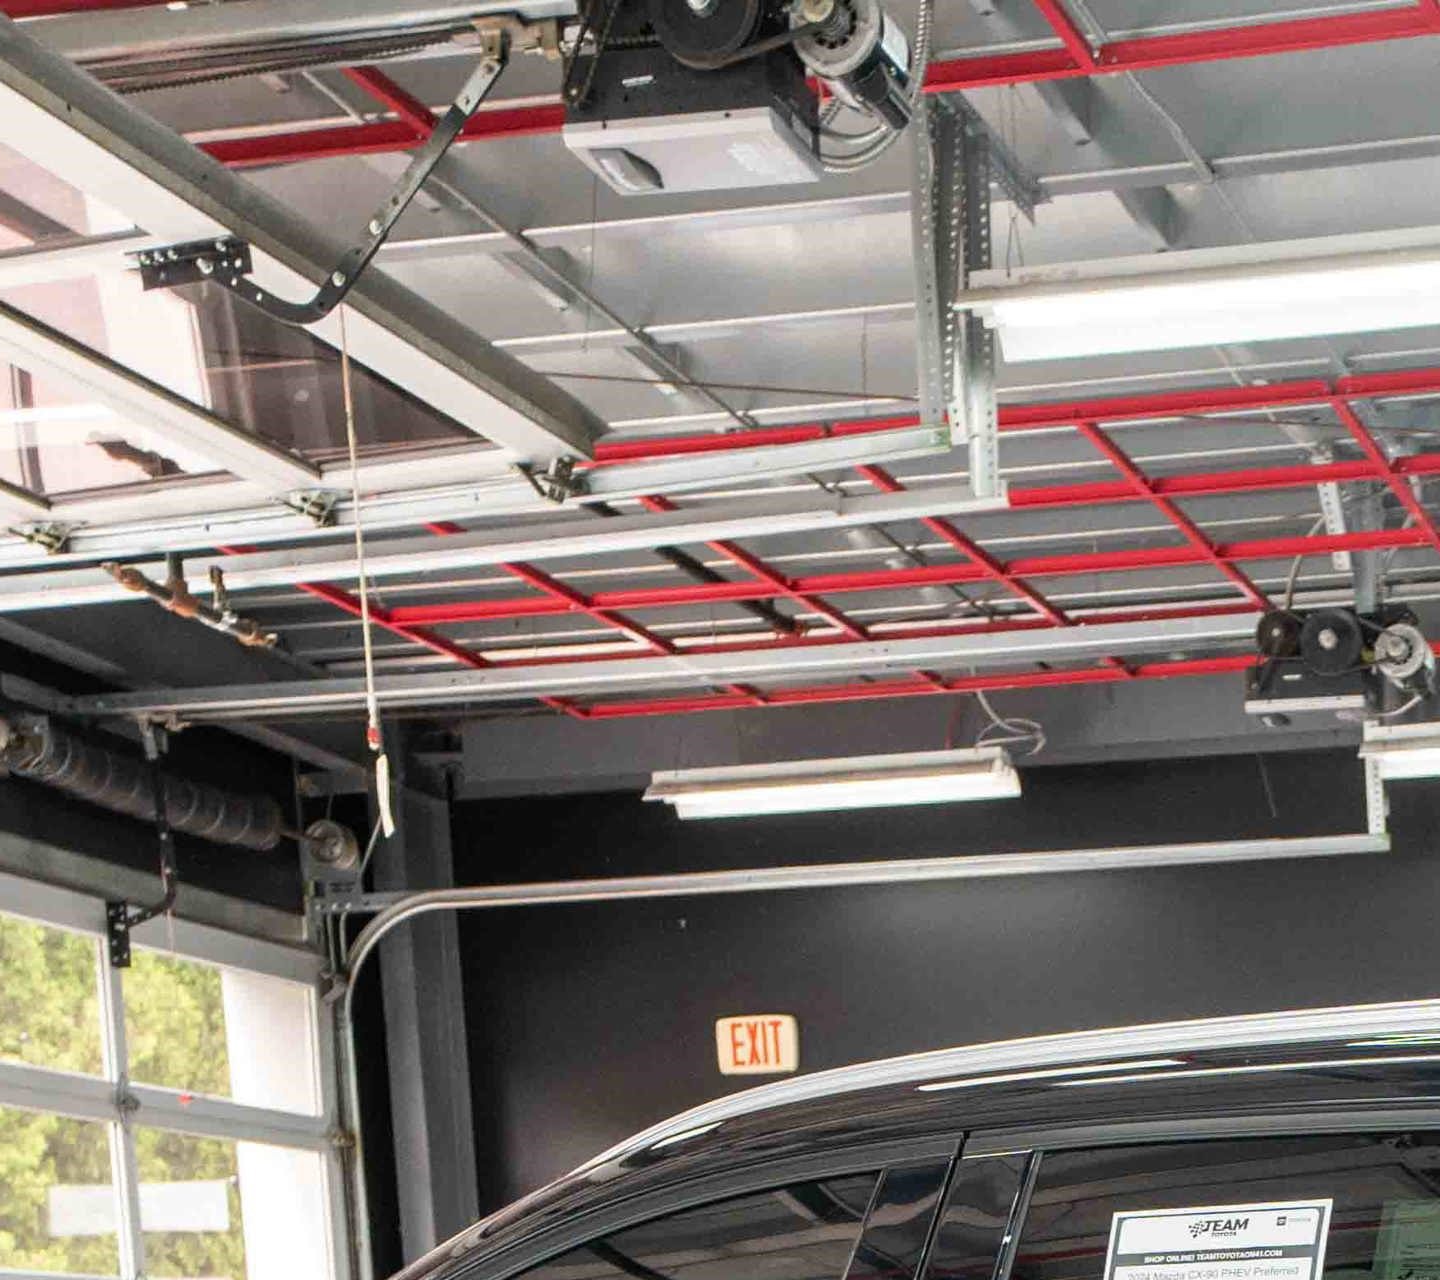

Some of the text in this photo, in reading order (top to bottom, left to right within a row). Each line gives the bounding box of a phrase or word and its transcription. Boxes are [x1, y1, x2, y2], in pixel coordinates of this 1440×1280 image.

[730, 1020, 783, 1067] EXIT
[1201, 1218, 1250, 1233] TEAM
[1143, 1255, 1165, 1264] SHOP
[1221, 1268, 1251, 1279] PHEV
[1253, 1266, 1299, 1277] Preferred
